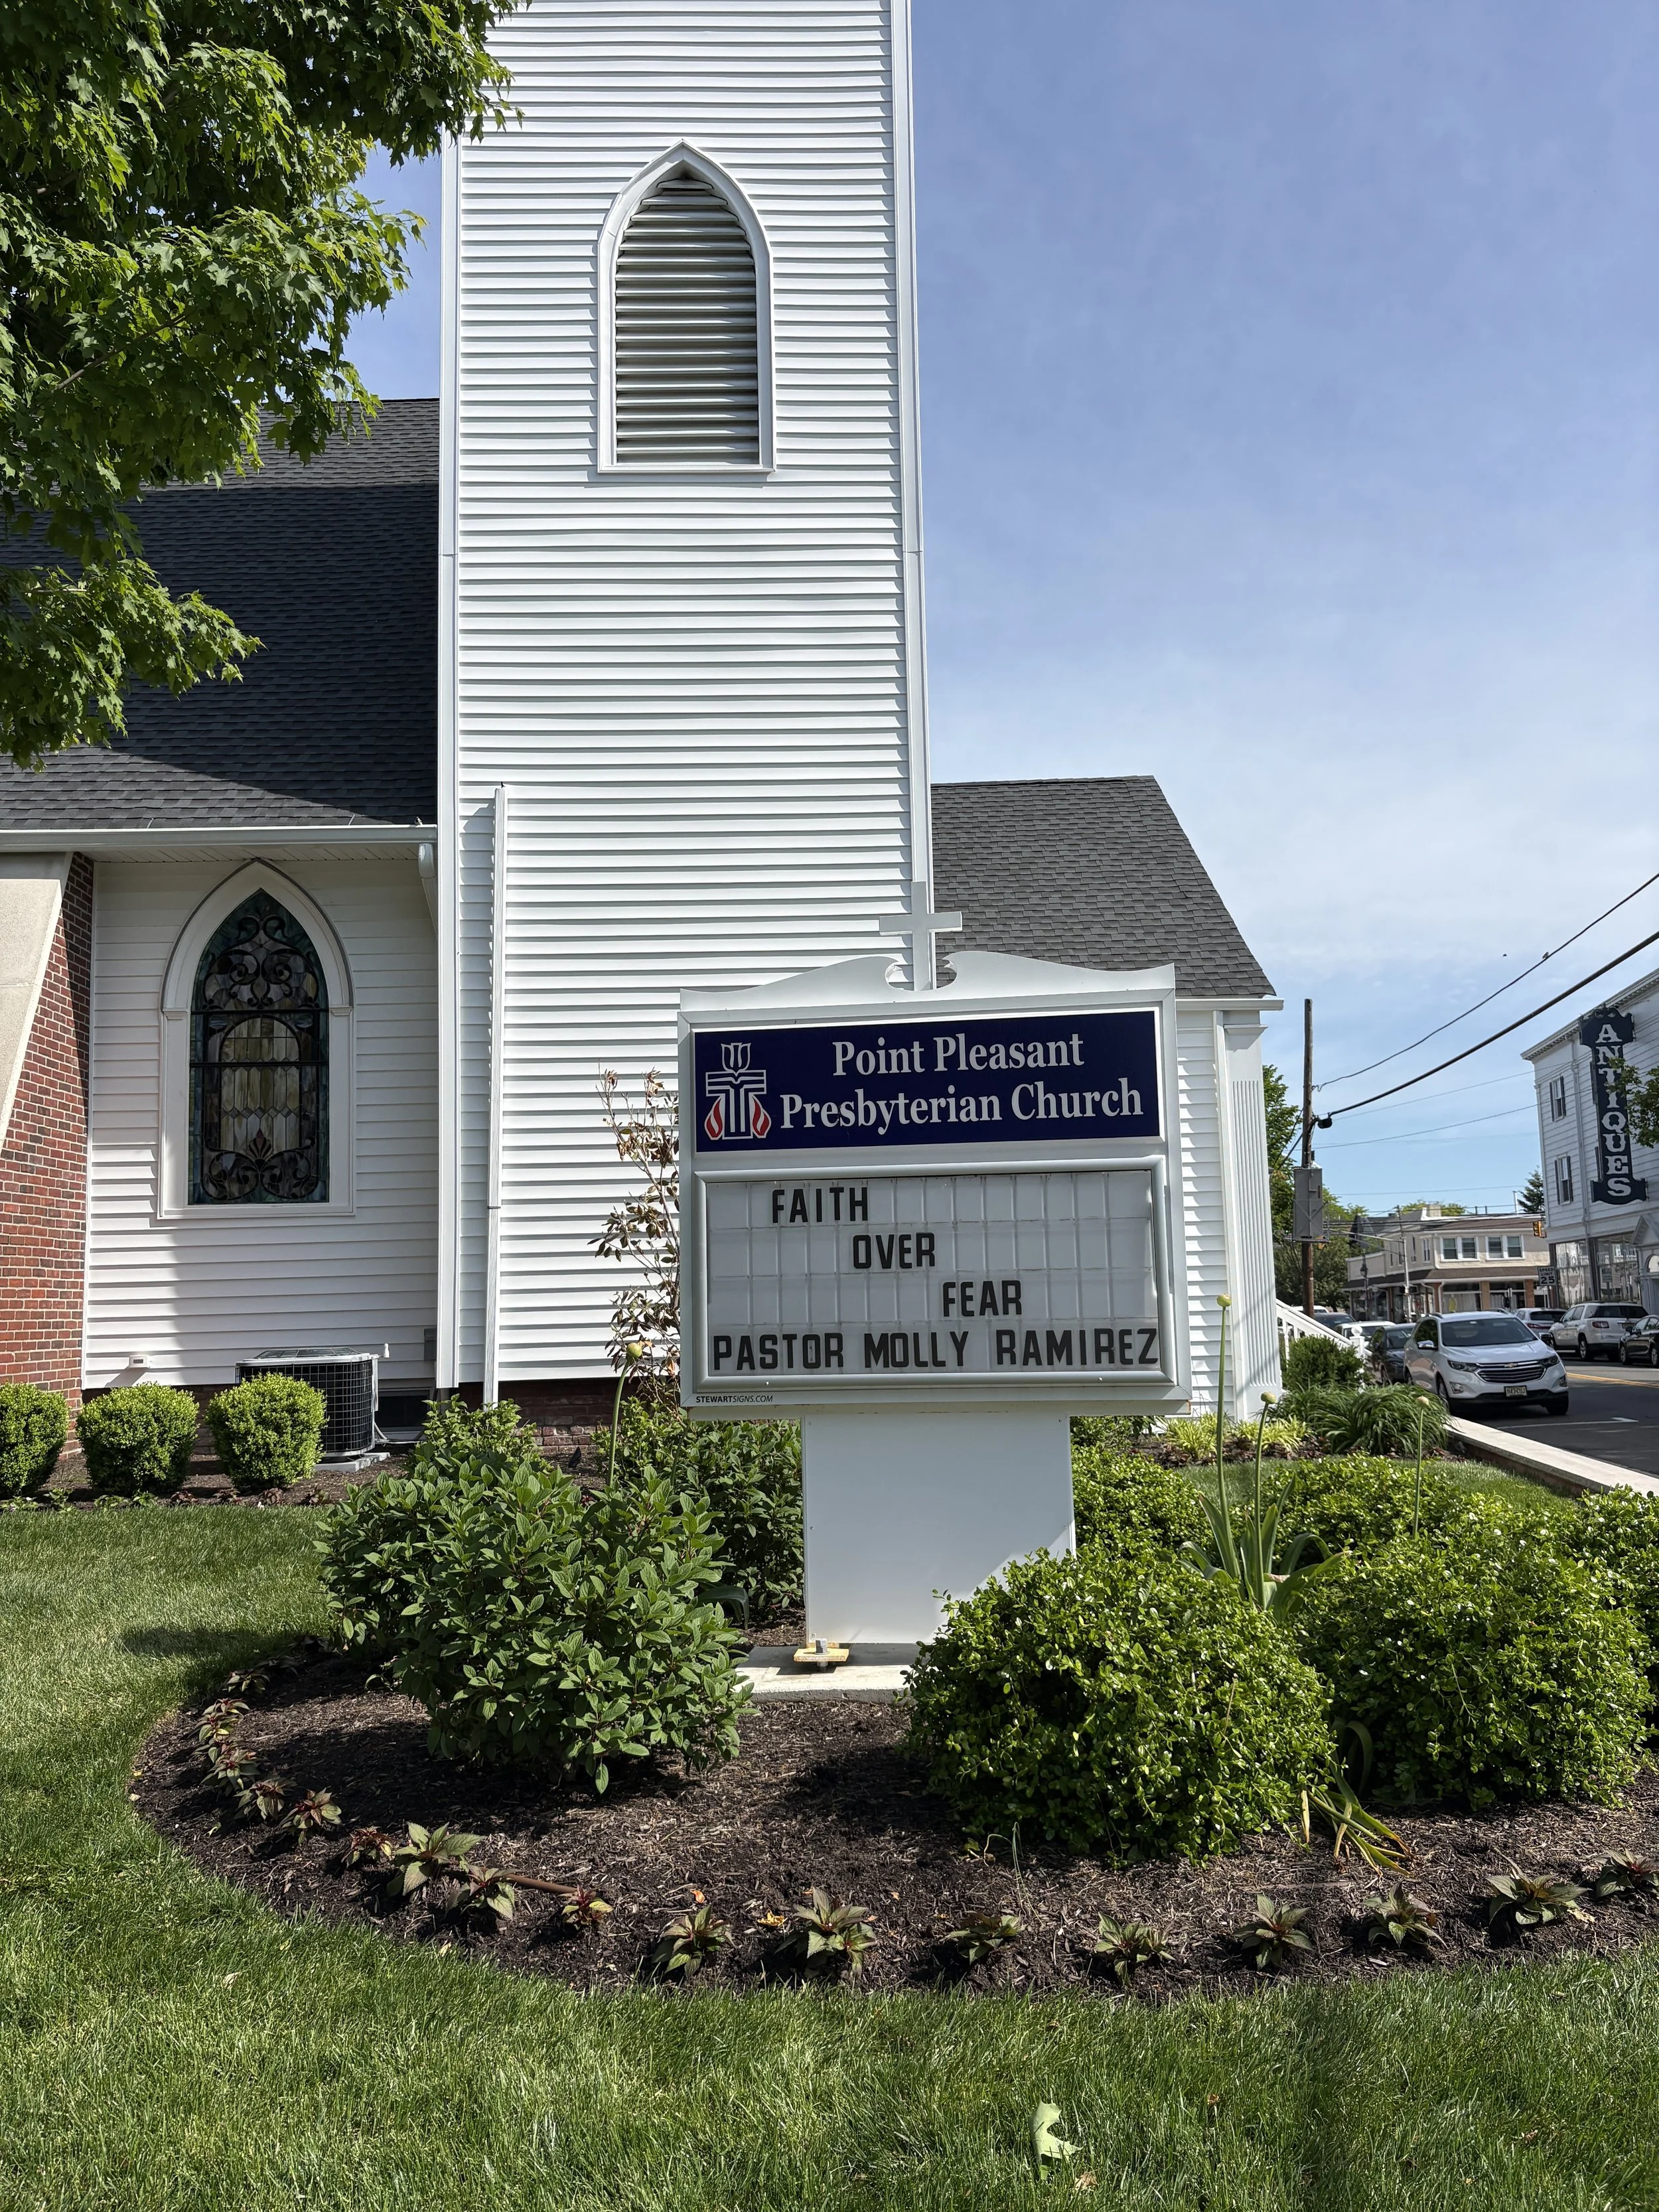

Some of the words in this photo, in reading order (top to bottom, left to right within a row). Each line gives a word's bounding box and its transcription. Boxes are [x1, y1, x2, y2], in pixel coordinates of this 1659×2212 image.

[832, 1037, 924, 1076] Point
[933, 1033, 1084, 1071] Pleasant
[780, 1085, 1002, 1135] Presbyterian
[1011, 1078, 1143, 1121] Church
[1595, 1023, 1631, 1196] ANTIQUES
[772, 1187, 869, 1223] FAITH
[853, 1232, 935, 1269] OVER
[943, 1280, 1022, 1317] FEAR
[714, 1333, 844, 1370] PASTOR
[864, 1331, 970, 1368] MOLLY
[997, 1328, 1159, 1365] RAMIREZ
